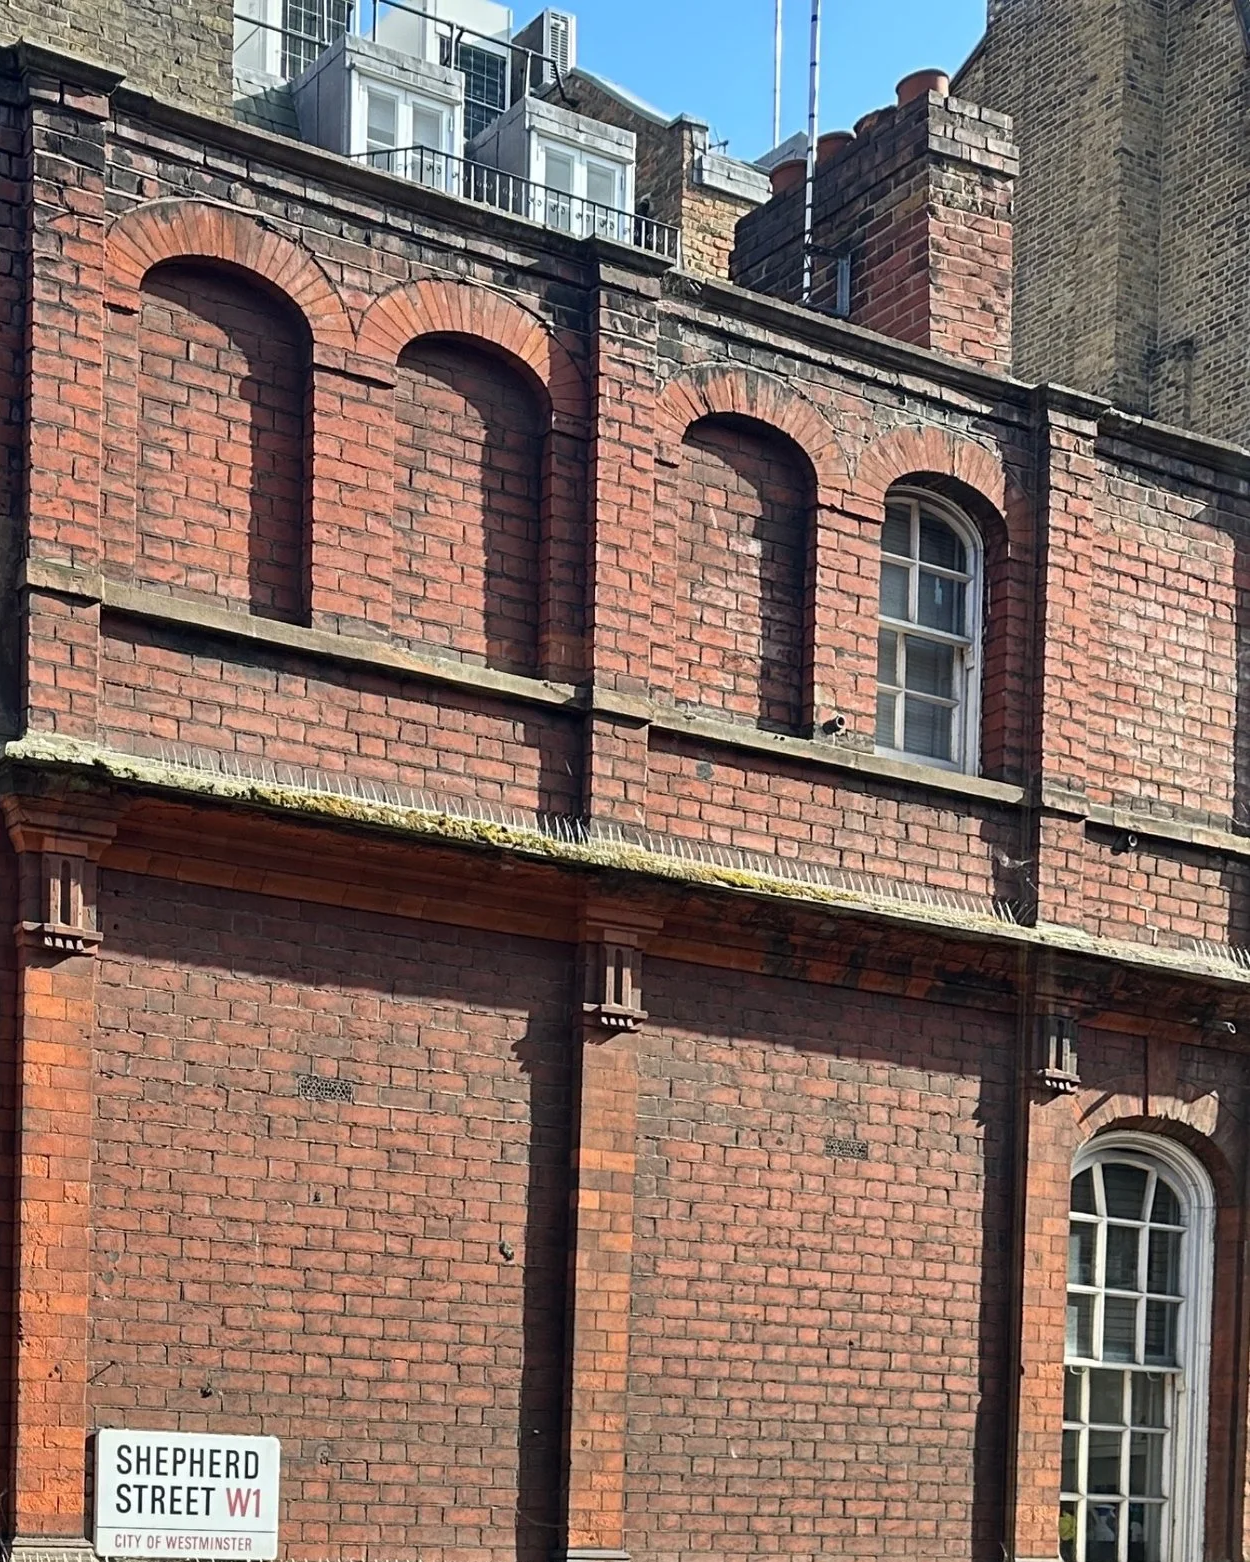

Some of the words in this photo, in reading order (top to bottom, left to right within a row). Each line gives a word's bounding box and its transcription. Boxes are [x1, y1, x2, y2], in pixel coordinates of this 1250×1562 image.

[116, 1444, 259, 1479] SHEPHERD
[116, 1483, 215, 1516] STREET
[225, 1487, 261, 1518] W1
[115, 1534, 141, 1548] CITY
[147, 1535, 162, 1549] OF
[166, 1536, 252, 1551] WESTMINSTER
